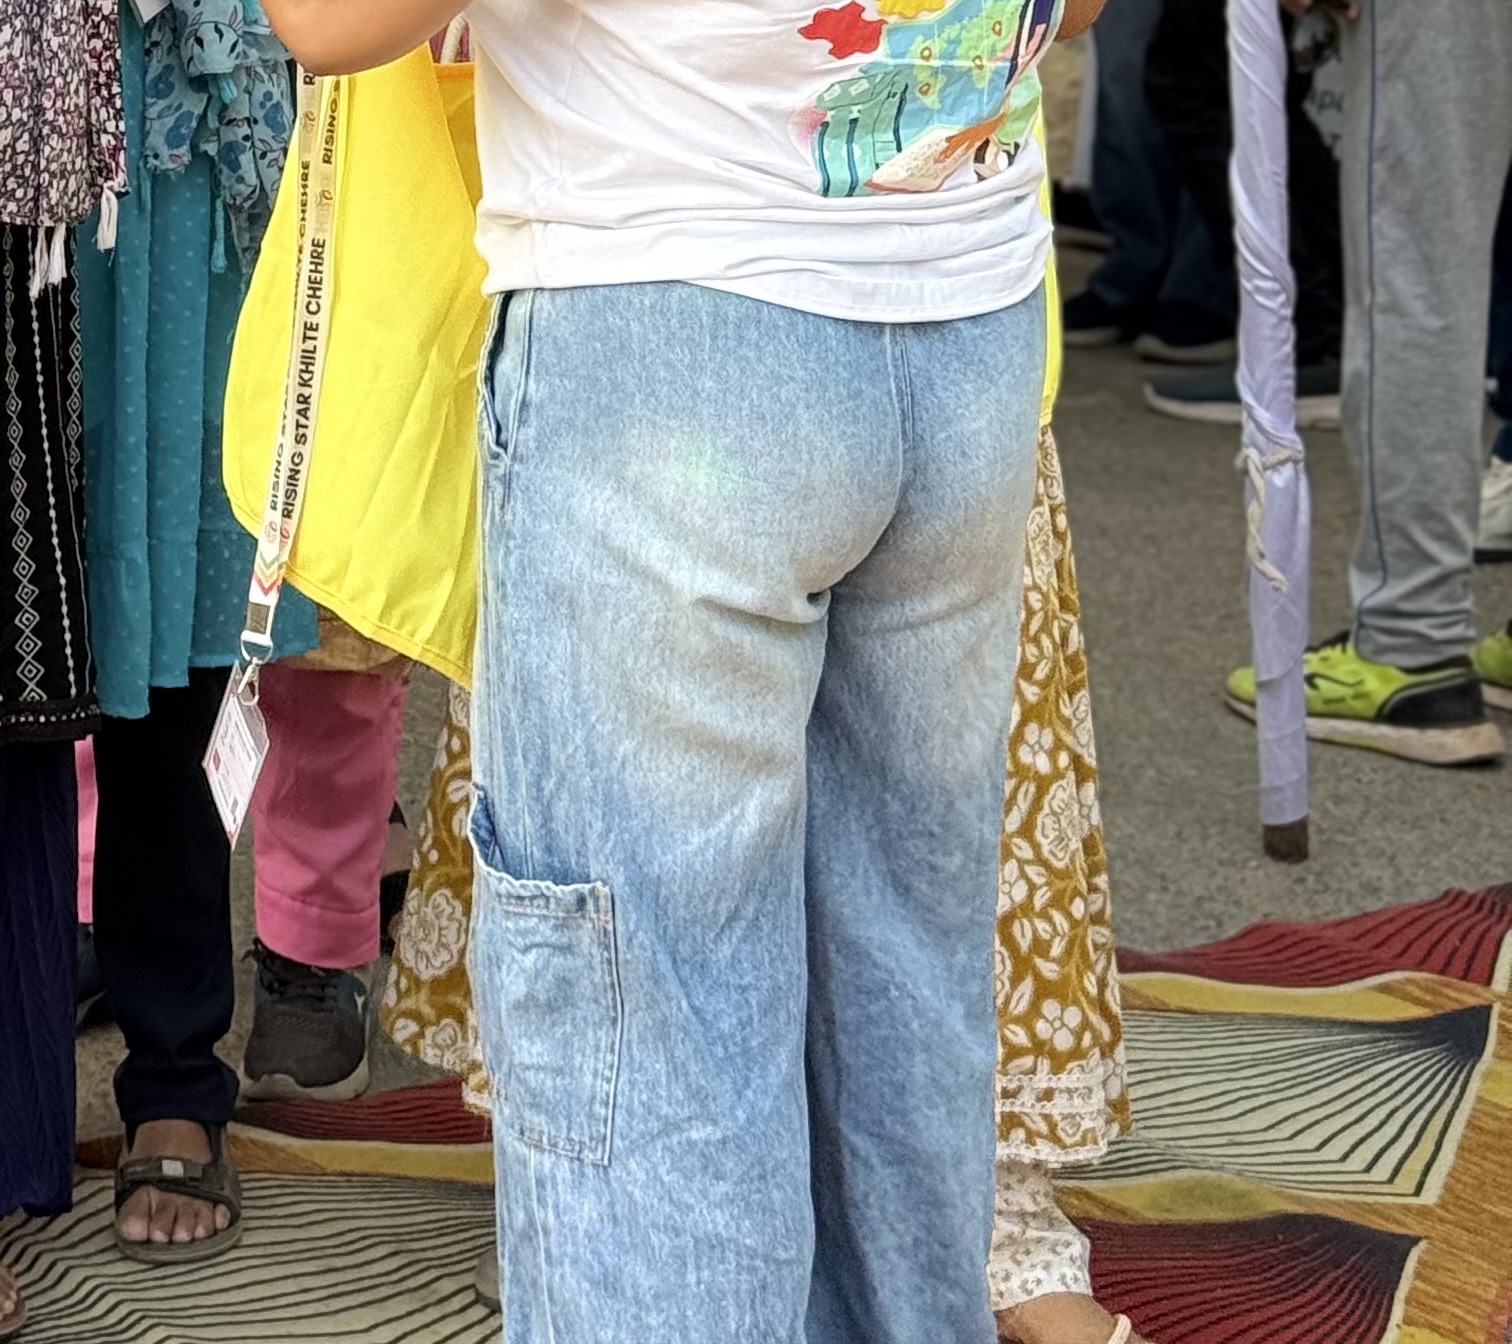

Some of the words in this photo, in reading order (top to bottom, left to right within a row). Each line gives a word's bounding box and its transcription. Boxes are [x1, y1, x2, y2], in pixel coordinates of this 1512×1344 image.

[321, 97, 338, 165] RISING
[304, 236, 326, 316] CHEHRE
[298, 320, 320, 389] KHILTE
[294, 392, 313, 448] STAR
[281, 450, 305, 520] RISING
